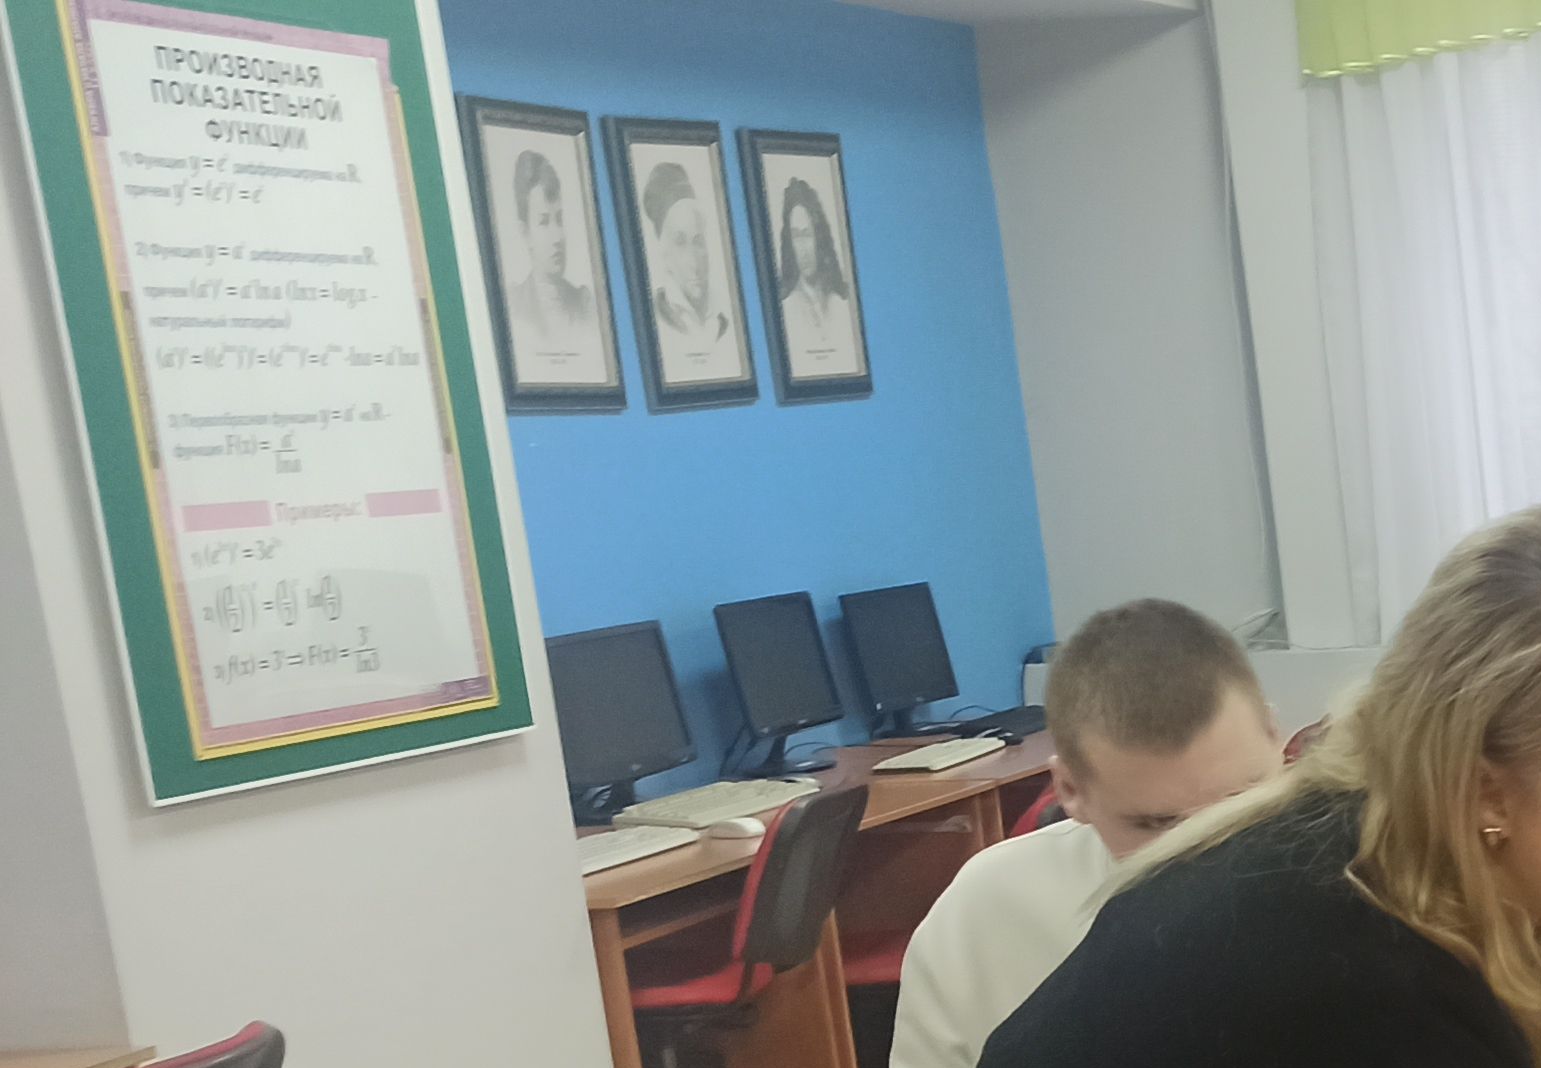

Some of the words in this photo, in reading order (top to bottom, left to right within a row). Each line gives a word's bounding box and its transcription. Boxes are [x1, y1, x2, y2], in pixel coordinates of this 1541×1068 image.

[154, 45, 323, 88] ПРОИЗВОДНАЯ
[151, 78, 343, 122] ПОКАЗАТЕЛЬНОЙ
[205, 119, 309, 150] ФУНКЦИИ
